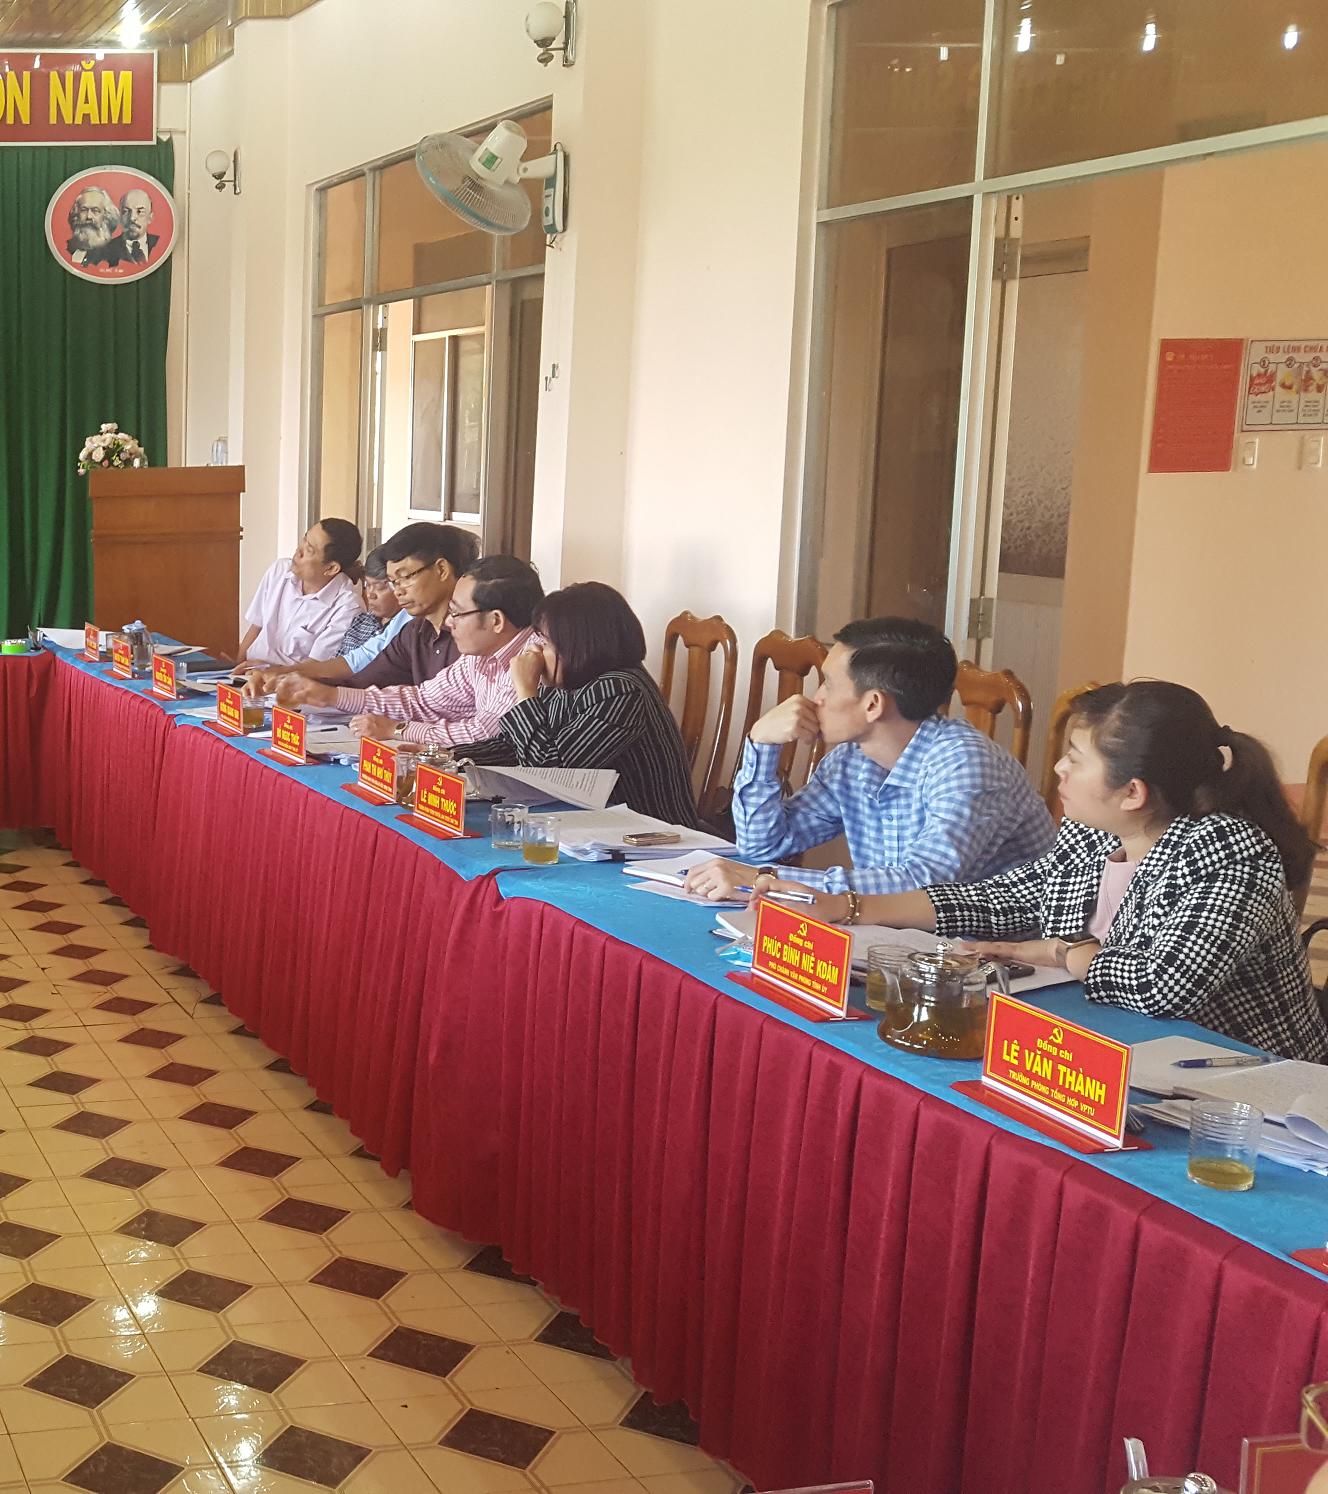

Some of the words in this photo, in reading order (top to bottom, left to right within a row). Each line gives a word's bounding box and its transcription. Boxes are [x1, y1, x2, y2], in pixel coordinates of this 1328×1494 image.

[49, 59, 133, 125] NĂM
[762, 935, 781, 958] PHÚC
[1002, 1040, 1020, 1066] LÊ
[1025, 1049, 1053, 1080] VĂN
[1058, 1063, 1107, 1105] THÀNH
